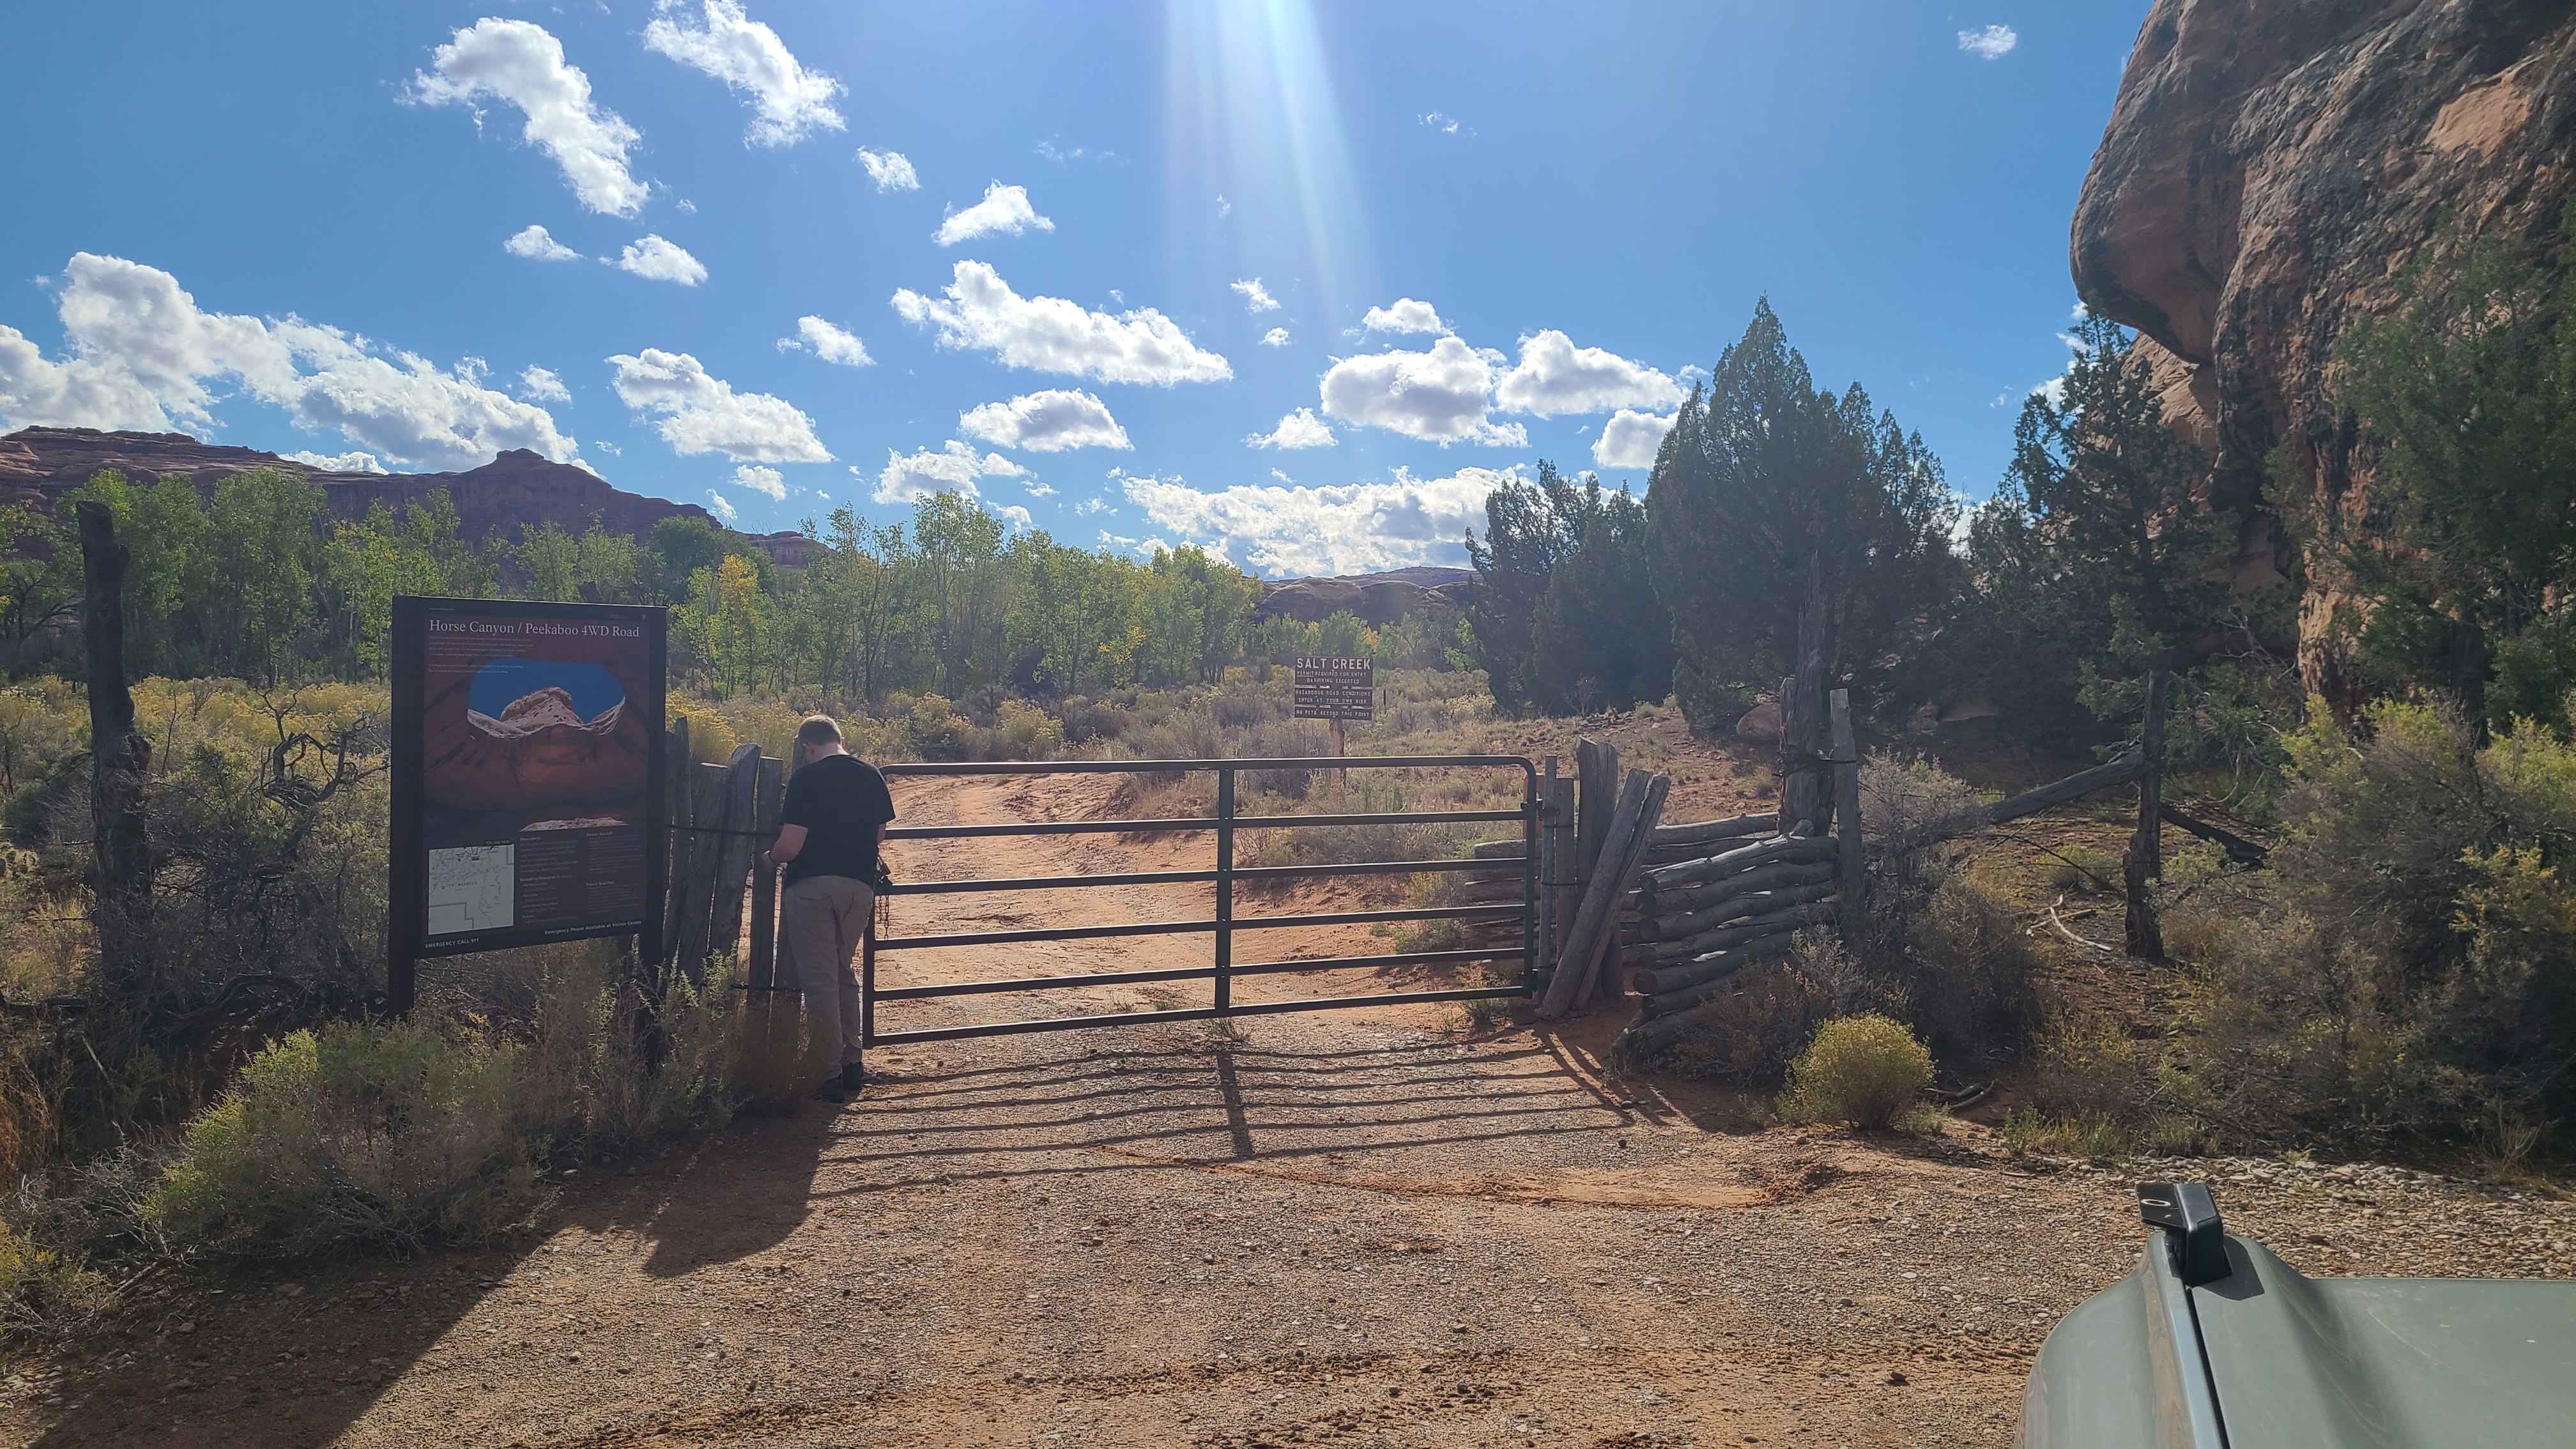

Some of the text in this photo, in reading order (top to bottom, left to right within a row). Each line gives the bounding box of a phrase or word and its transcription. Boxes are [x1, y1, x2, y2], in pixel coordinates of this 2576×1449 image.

[429, 620, 466, 632] Horse
[469, 622, 514, 636] Canyon
[525, 624, 578, 635] Peekaboo
[581, 625, 609, 636] 4WD
[612, 627, 639, 637] Road
[1297, 657, 1370, 670] SALT CREEK
